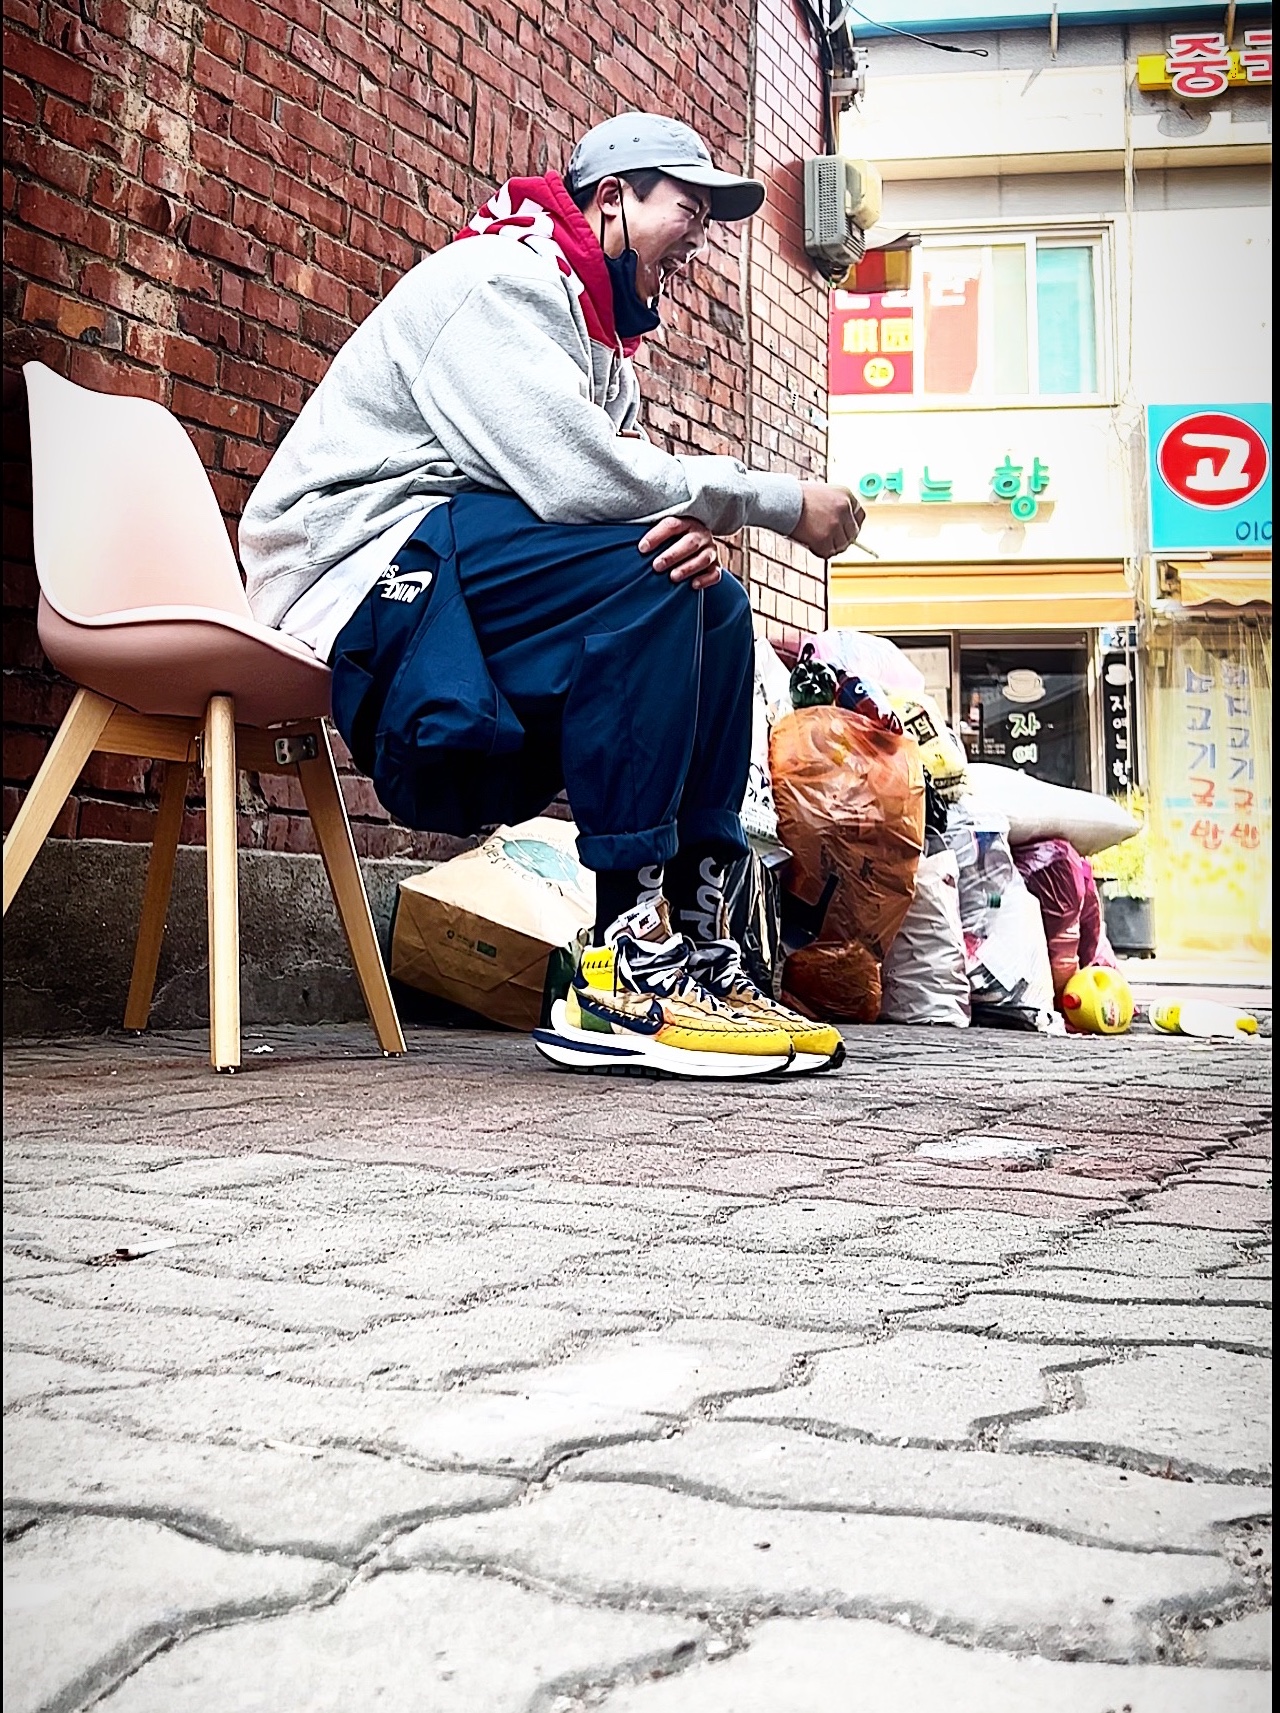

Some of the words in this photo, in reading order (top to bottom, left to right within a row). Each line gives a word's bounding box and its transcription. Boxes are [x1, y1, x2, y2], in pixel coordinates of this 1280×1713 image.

[1181, 433, 1250, 491] 고
[381, 582, 421, 603] NIKE
[1008, 711, 1042, 770] 자여
